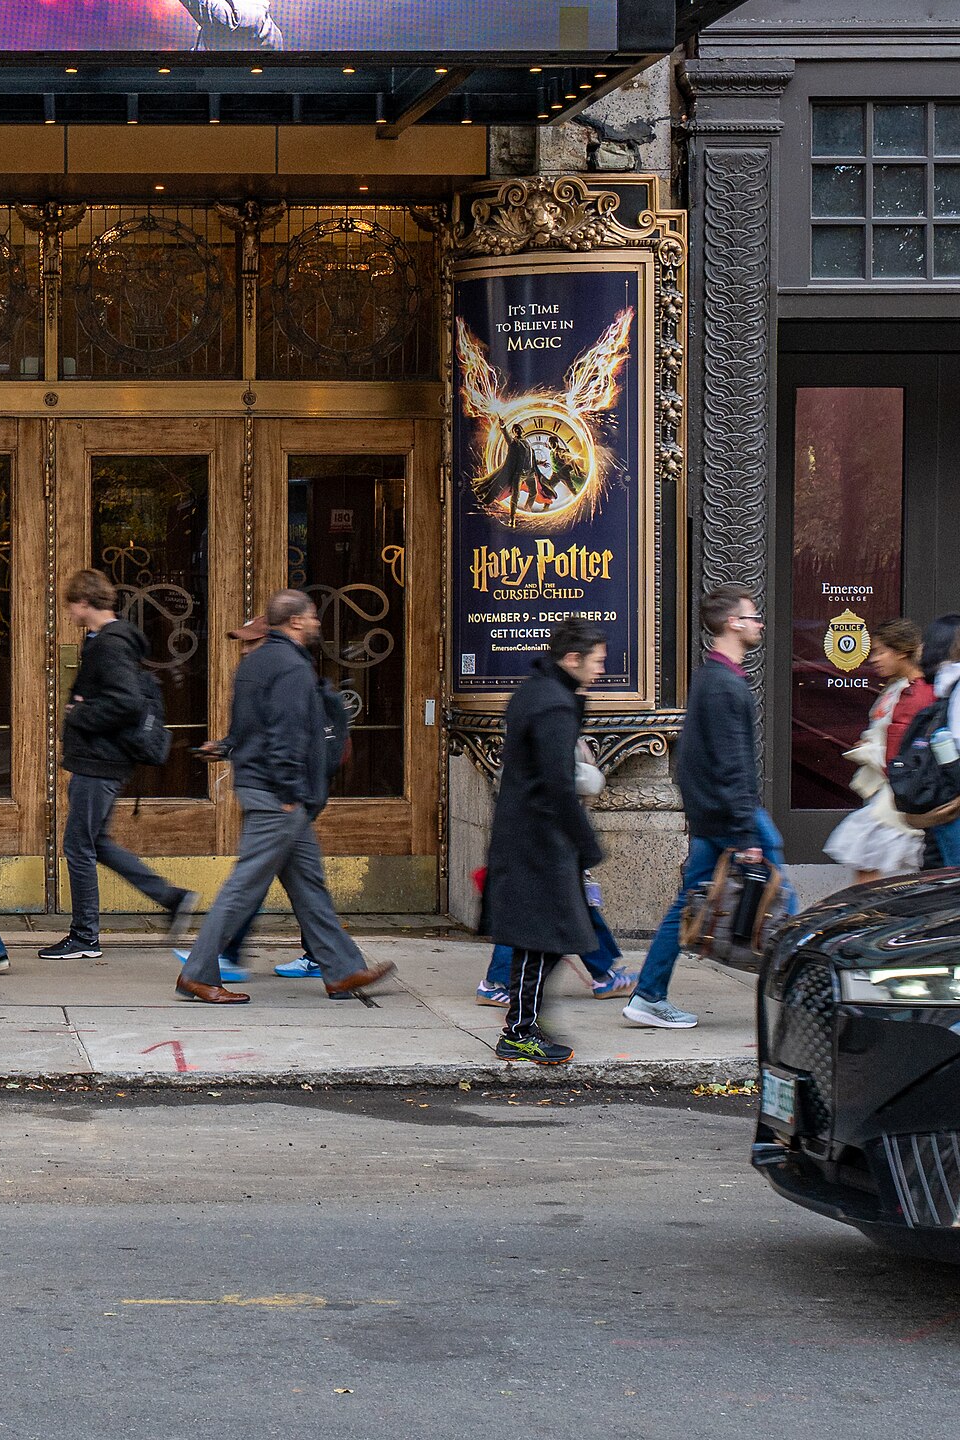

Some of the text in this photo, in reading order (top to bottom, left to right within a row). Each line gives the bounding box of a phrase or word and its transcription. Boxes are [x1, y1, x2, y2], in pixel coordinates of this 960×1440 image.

[469, 538, 614, 595] Harry Potter
[493, 588, 584, 600] CURSED CHILD
[821, 582, 874, 595] Emerson
[468, 613, 521, 624] NOVEMBER
[522, 612, 530, 622] 9
[603, 611, 617, 621] 20
[490, 628, 551, 638] GET TICKETS
[491, 644, 552, 652] EmersonColonialTh
[827, 678, 869, 688] POLICE
